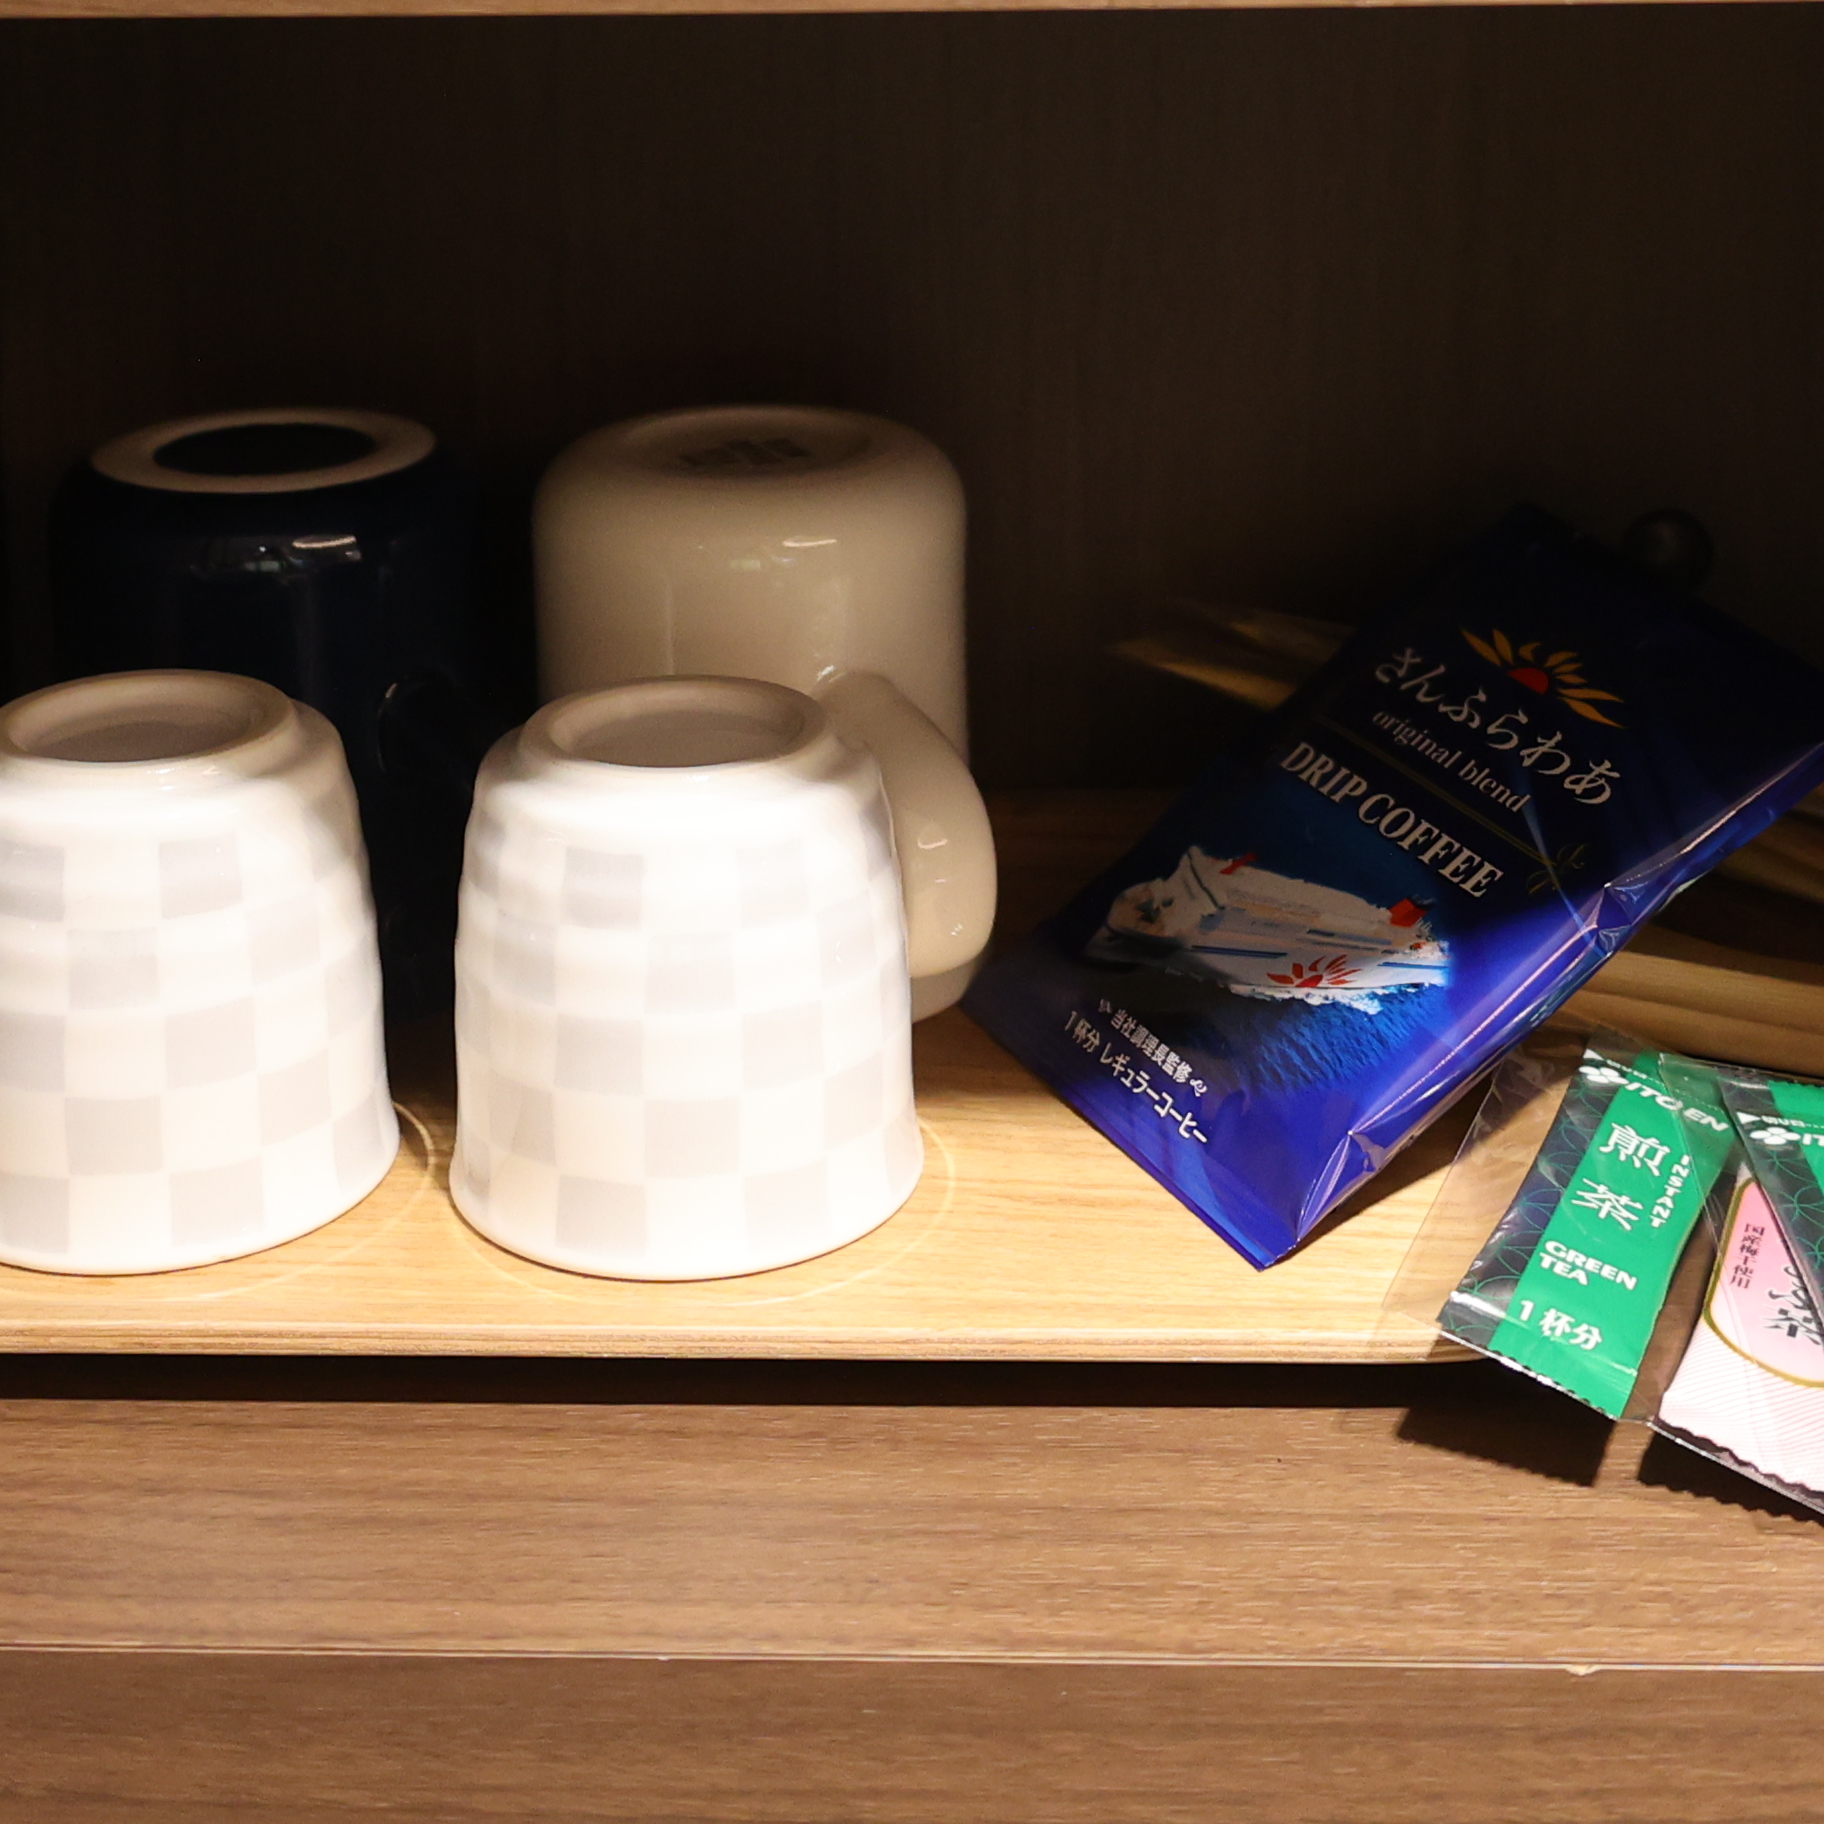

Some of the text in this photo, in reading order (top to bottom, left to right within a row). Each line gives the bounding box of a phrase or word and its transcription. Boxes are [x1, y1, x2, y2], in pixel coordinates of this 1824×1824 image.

[1372, 710, 1532, 813] original blend
[1375, 647, 1622, 805] さんふらわあ
[1280, 742, 1505, 897] DRIP COFFEE
[1064, 1010, 1208, 1143] 1杯分 レギュラーコーヒー
[1110, 1009, 1193, 1083] 当社調理長監修
[1624, 1081, 1730, 1132] ITO EN
[1571, 1121, 1671, 1231] 煎茶
[1650, 1154, 1690, 1228] INSTANT
[1539, 1252, 1588, 1285] TEA
[1544, 1240, 1638, 1290] GREEN
